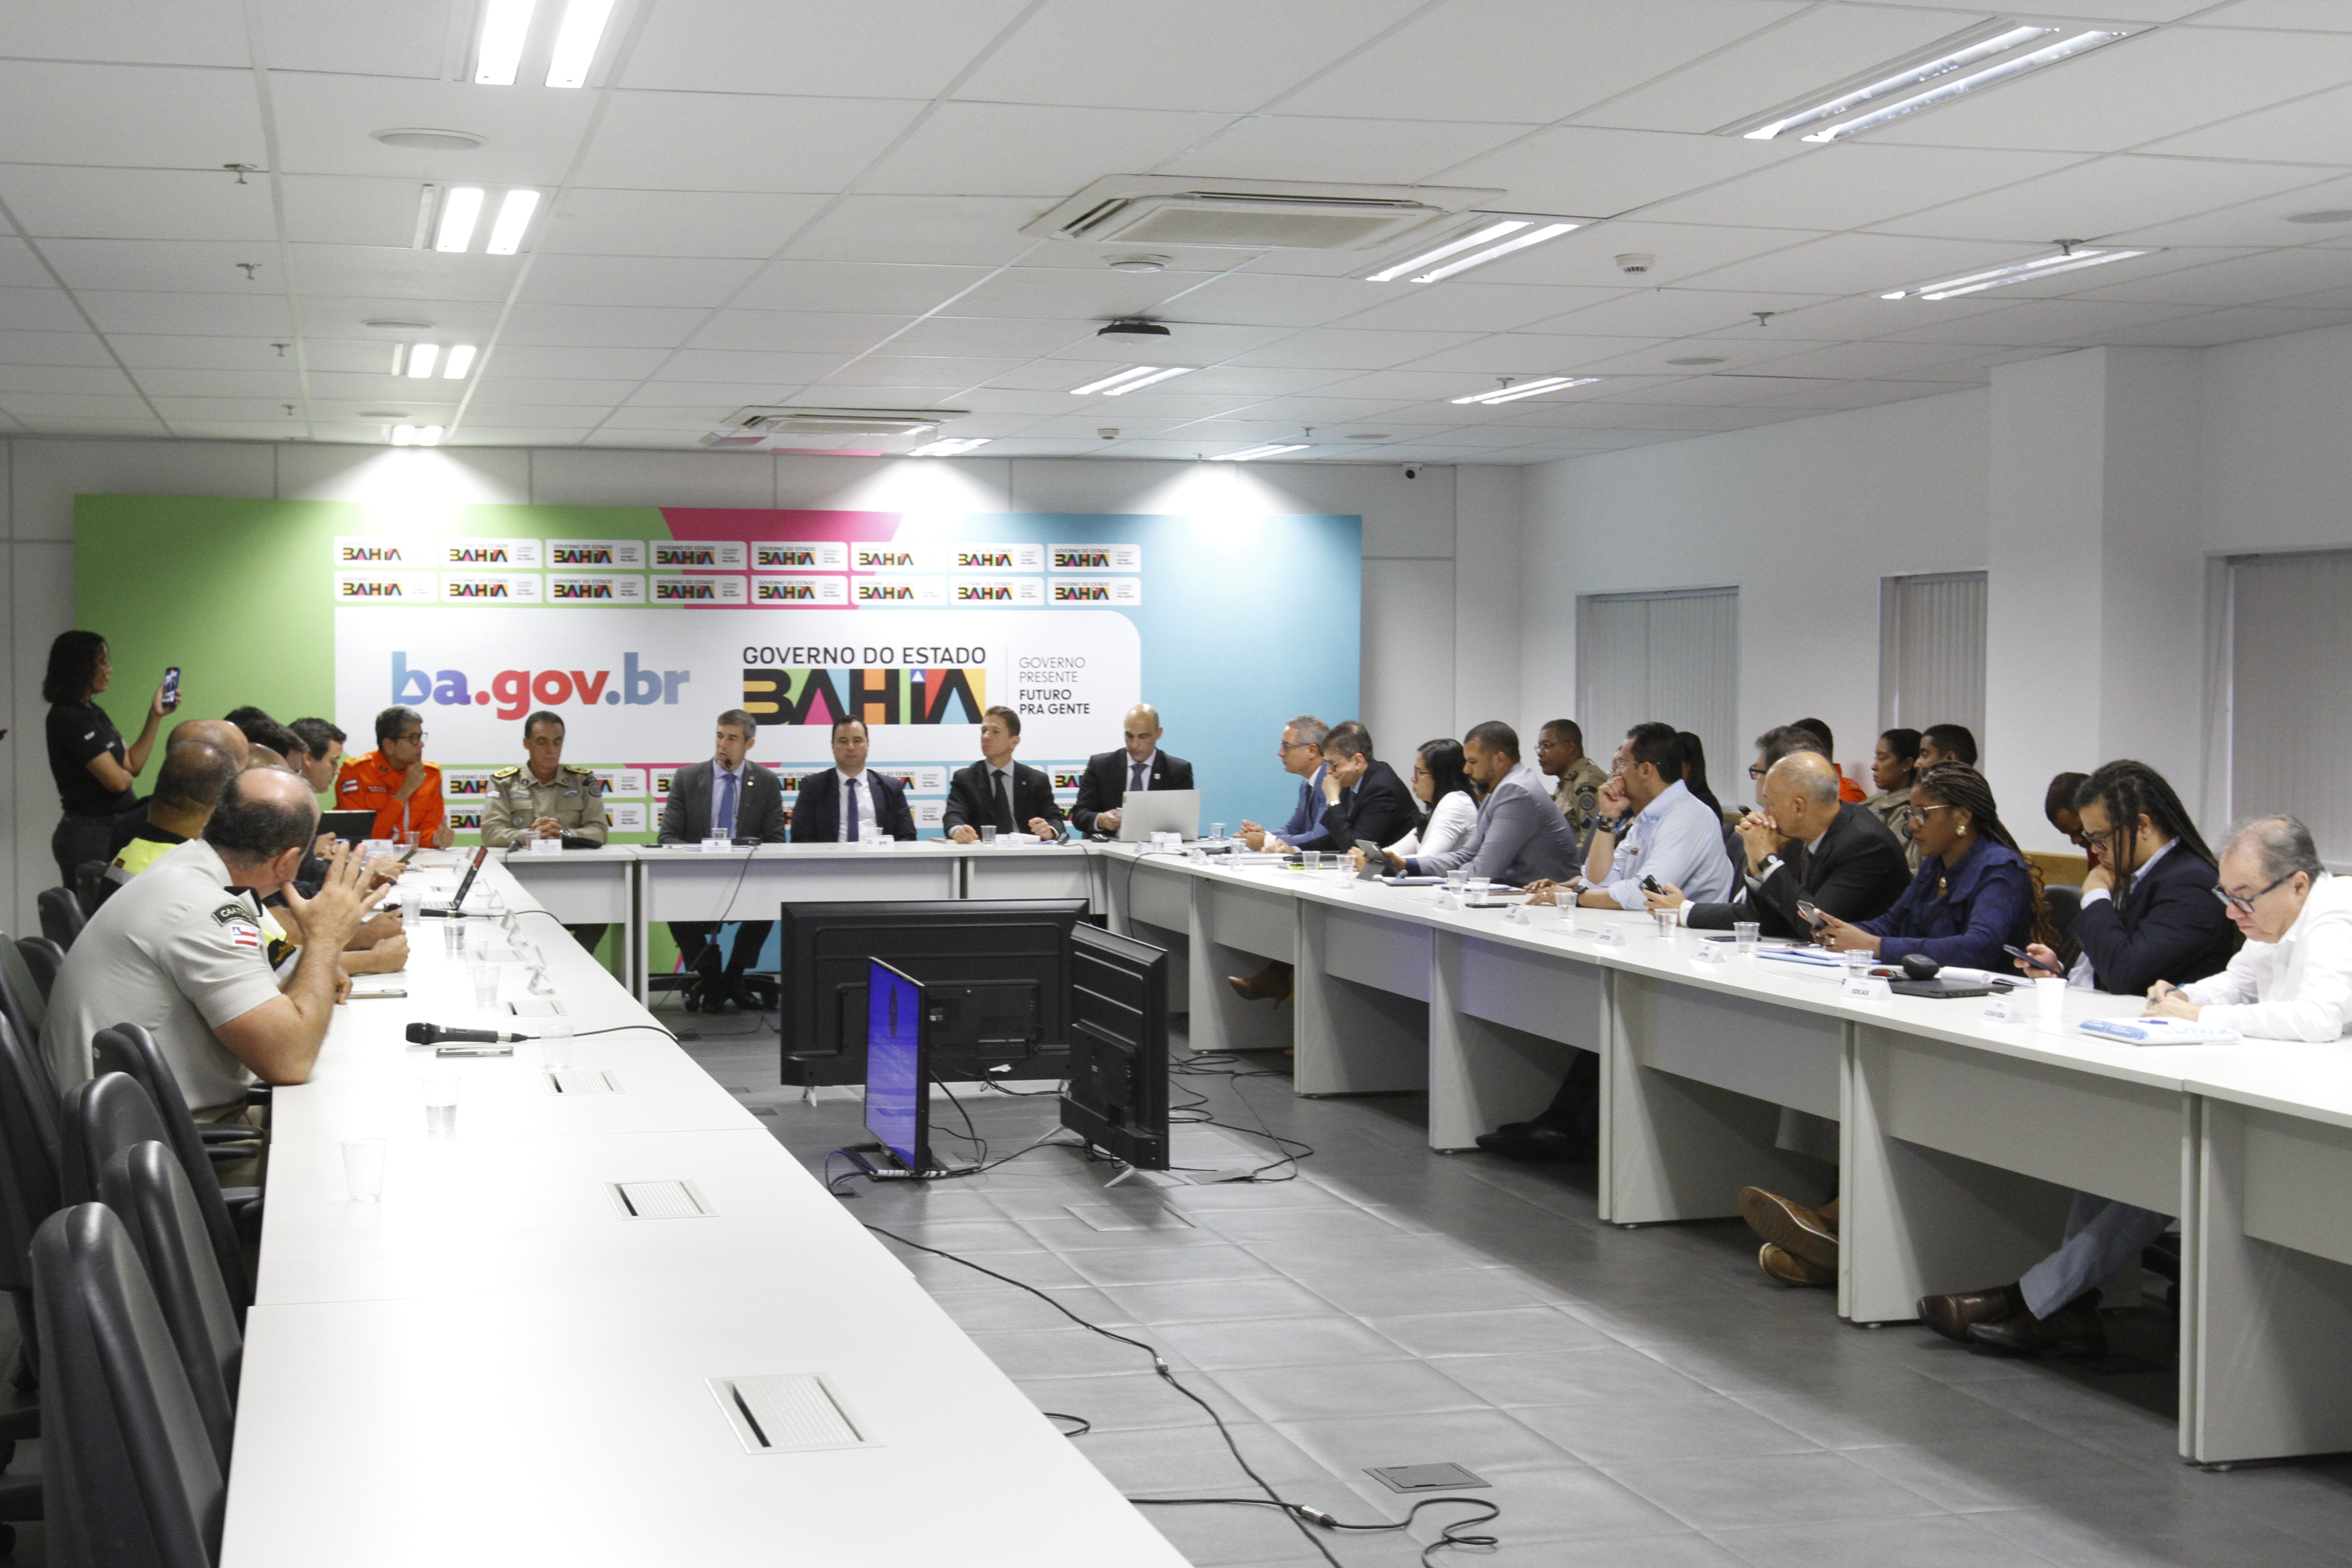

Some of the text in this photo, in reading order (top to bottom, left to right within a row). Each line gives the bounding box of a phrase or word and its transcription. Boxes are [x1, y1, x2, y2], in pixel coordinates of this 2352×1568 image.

[343, 548, 402, 560] BAHIA
[450, 549, 508, 561] BAHIA
[554, 550, 612, 563] BAHIA
[657, 551, 715, 564] BAHIA
[759, 552, 815, 564] BAHIA
[859, 553, 913, 565] BAHIA
[958, 554, 1012, 566] BAHIA
[1055, 554, 1109, 566] BAHIA
[343, 583, 402, 595] BAHIA
[450, 584, 508, 596] BAHIA
[554, 585, 612, 598] BAHIA
[657, 586, 715, 598] BAHIA
[759, 586, 815, 598] BAHIA
[859, 587, 913, 599] BAHIA
[958, 588, 1012, 599] BAHIA
[1055, 588, 1109, 599] BAHIA
[743, 647, 986, 664] GOVERNO DO ESTADO
[1019, 657, 1085, 668] GOVERNO
[1019, 671, 1078, 682] PRESENTE
[392, 651, 690, 720] ba.gov.br
[743, 669, 985, 725] BAHIA
[1019, 689, 1071, 700] FUTURO
[1019, 703, 1090, 715] PRA GENTE
[451, 780, 488, 794] BAH
